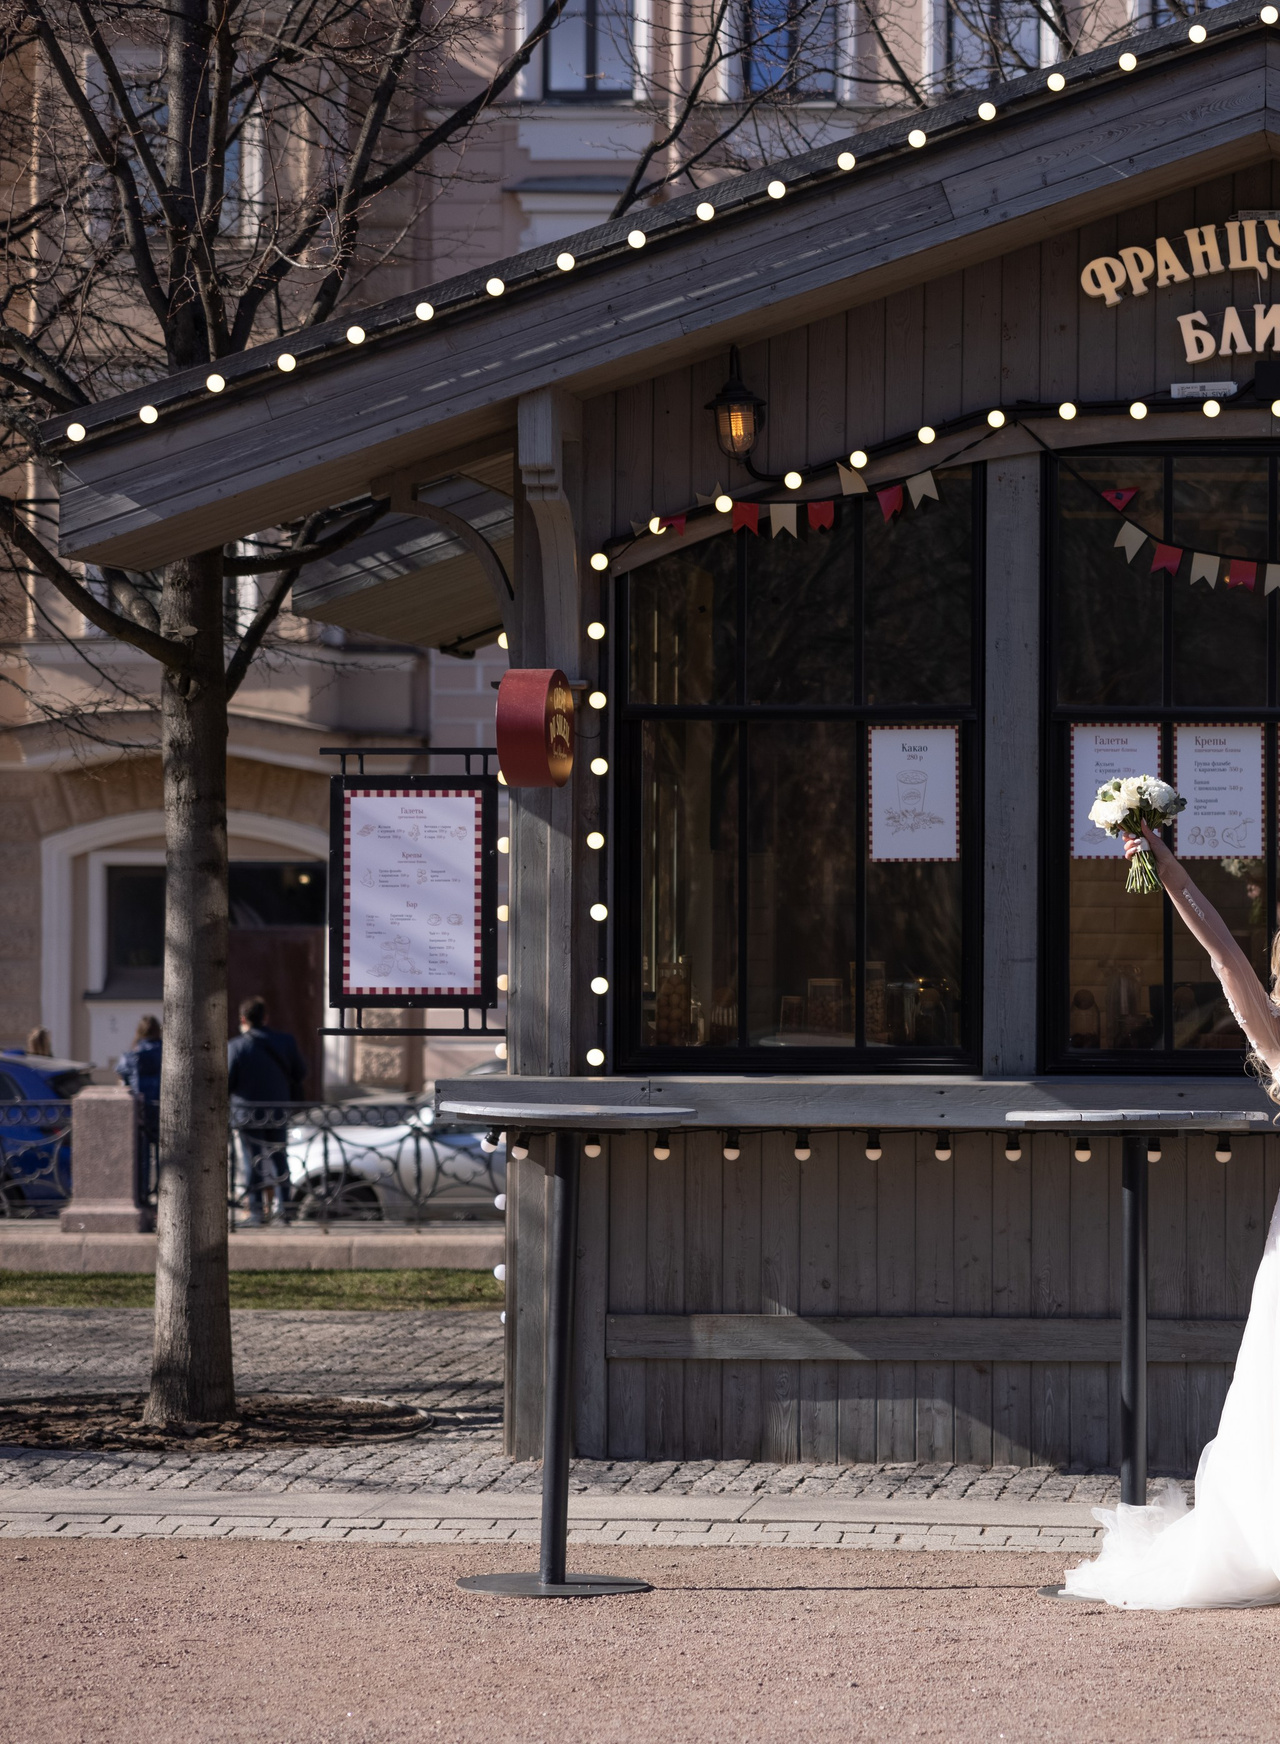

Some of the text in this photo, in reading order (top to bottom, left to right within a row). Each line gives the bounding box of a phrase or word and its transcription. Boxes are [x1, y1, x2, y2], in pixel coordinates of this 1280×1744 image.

[1094, 736, 1128, 745] Галеты
[1195, 736, 1227, 748] Крепы
[901, 743, 928, 752] Какао
[406, 901, 418, 909] Бар
